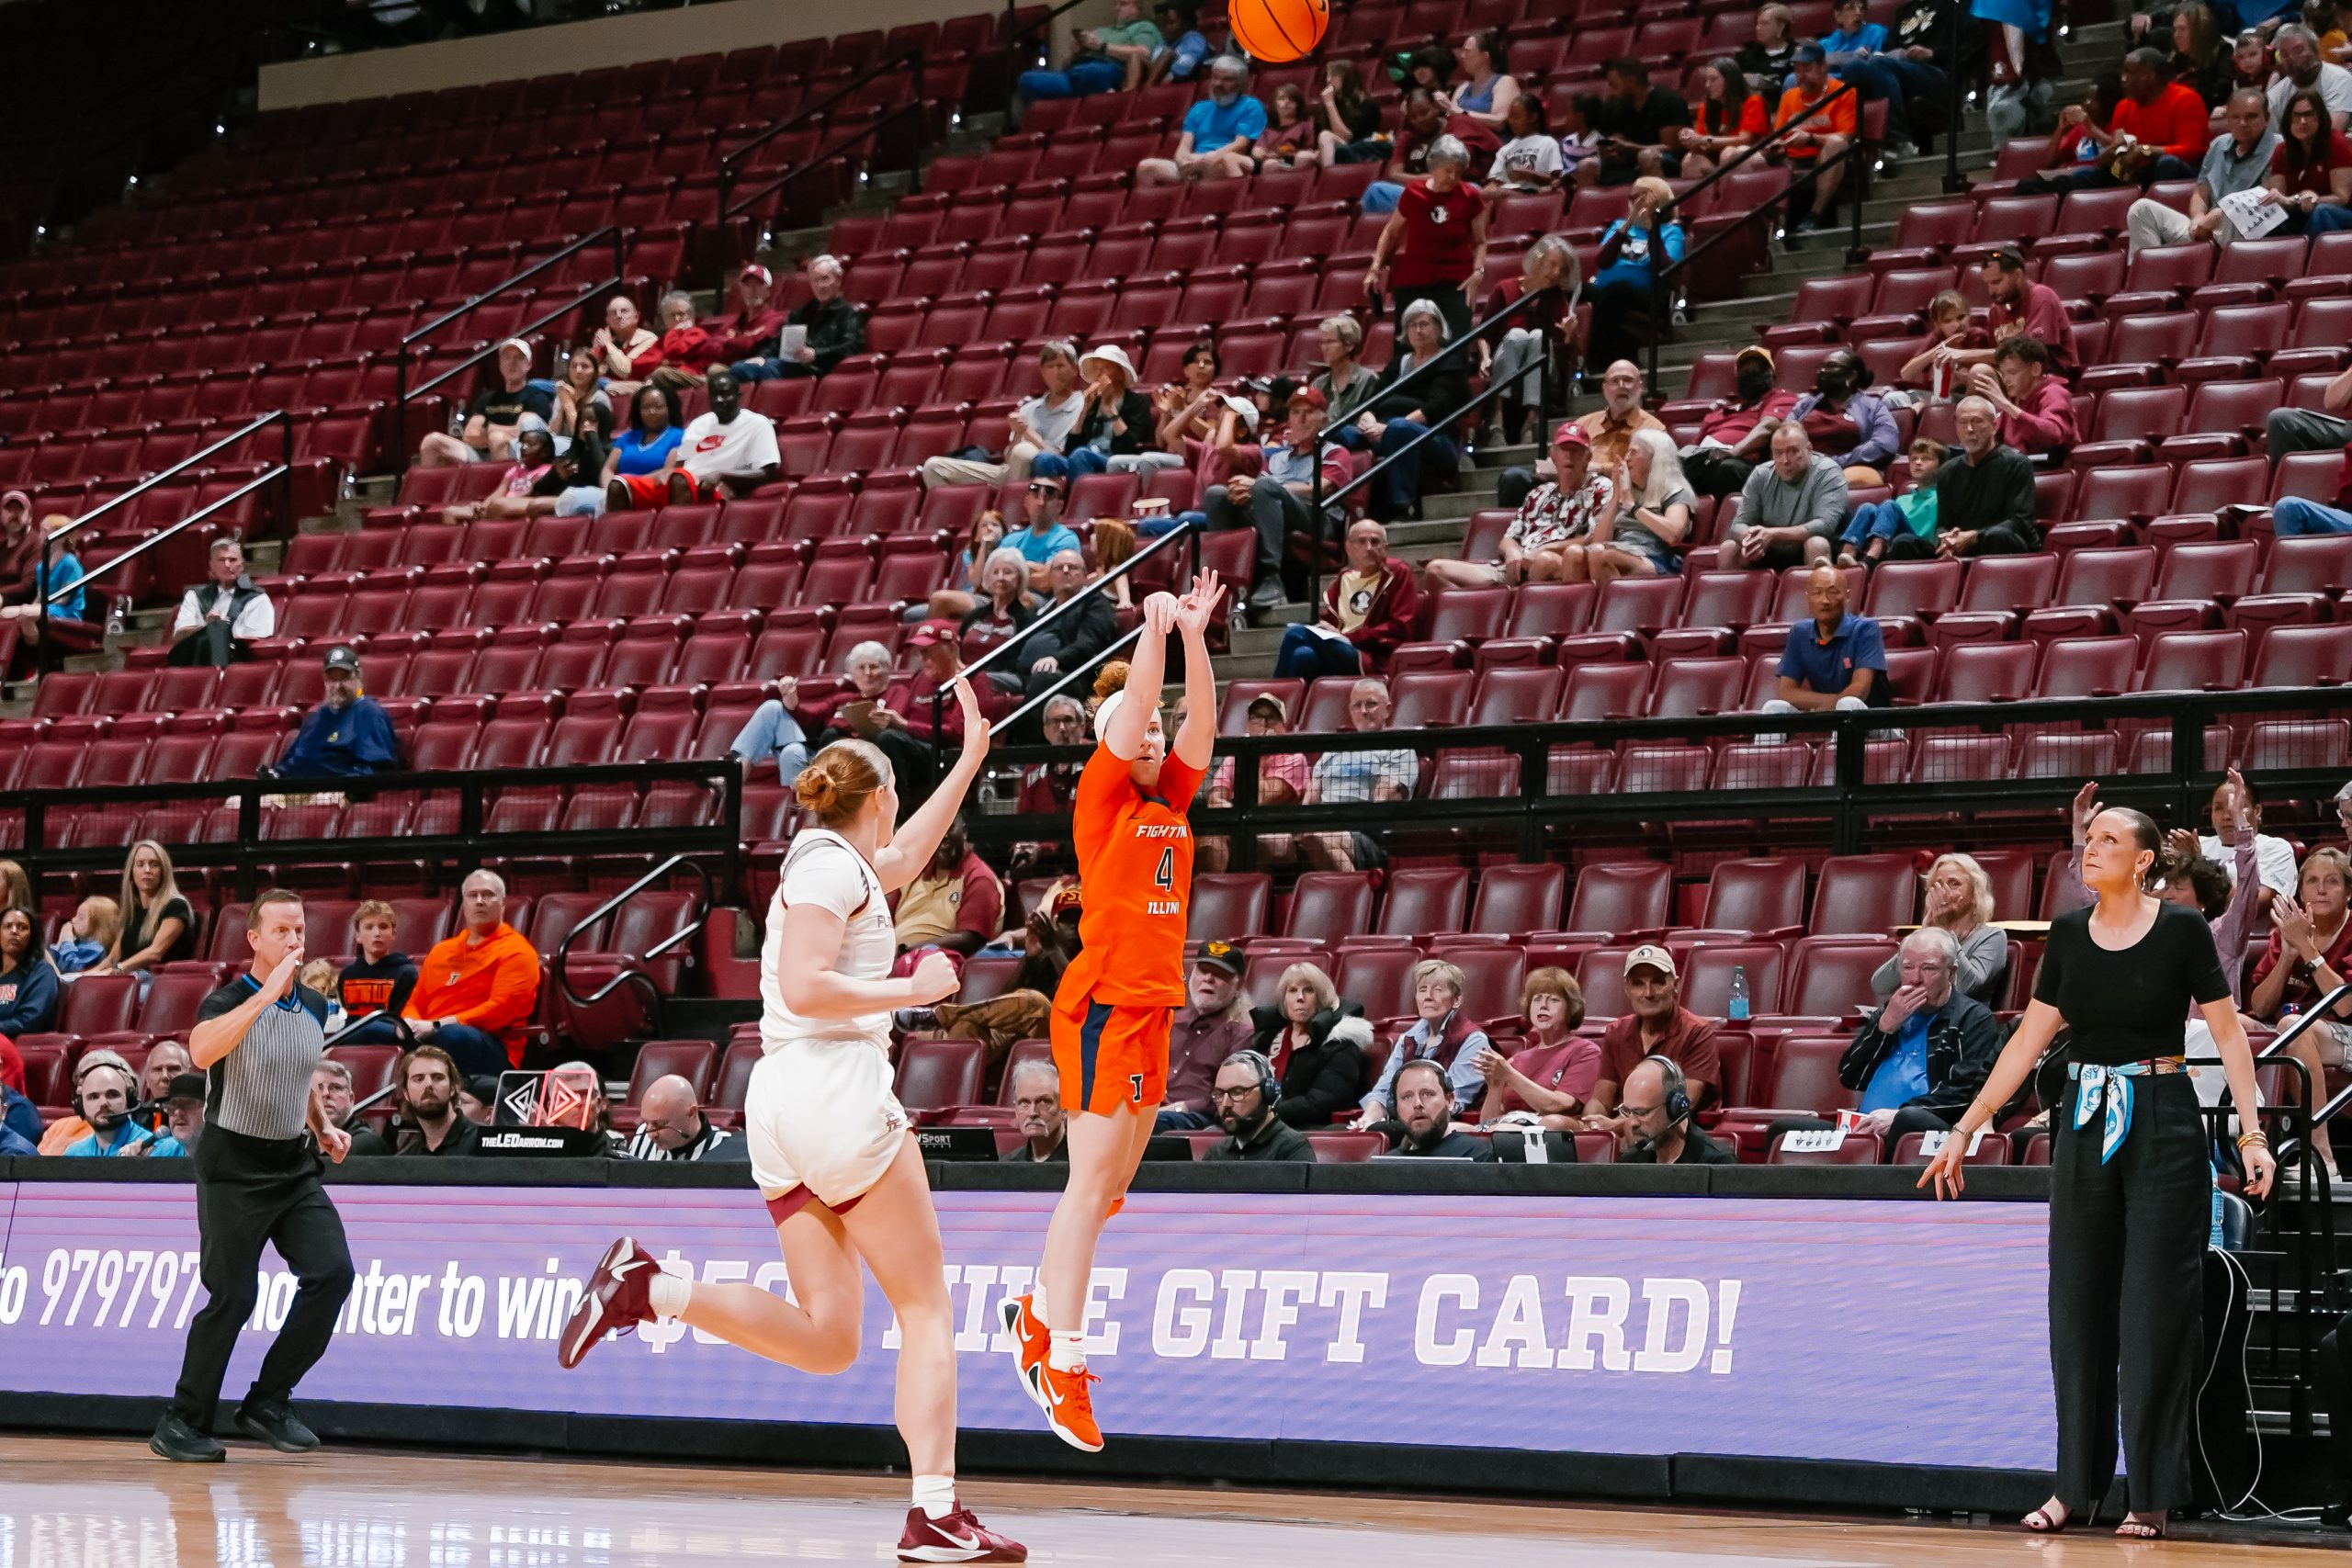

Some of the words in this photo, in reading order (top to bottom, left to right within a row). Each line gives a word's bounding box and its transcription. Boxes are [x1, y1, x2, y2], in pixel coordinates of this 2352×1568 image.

[1155, 846, 1173, 892] 4
[1130, 1074, 1143, 1103] I
[39, 1248, 201, 1329] 979797
[333, 1259, 431, 1336] nter
[438, 1260, 485, 1338] to
[1152, 1269, 1389, 1363] GIFT
[1413, 1273, 1741, 1374] CARD!
